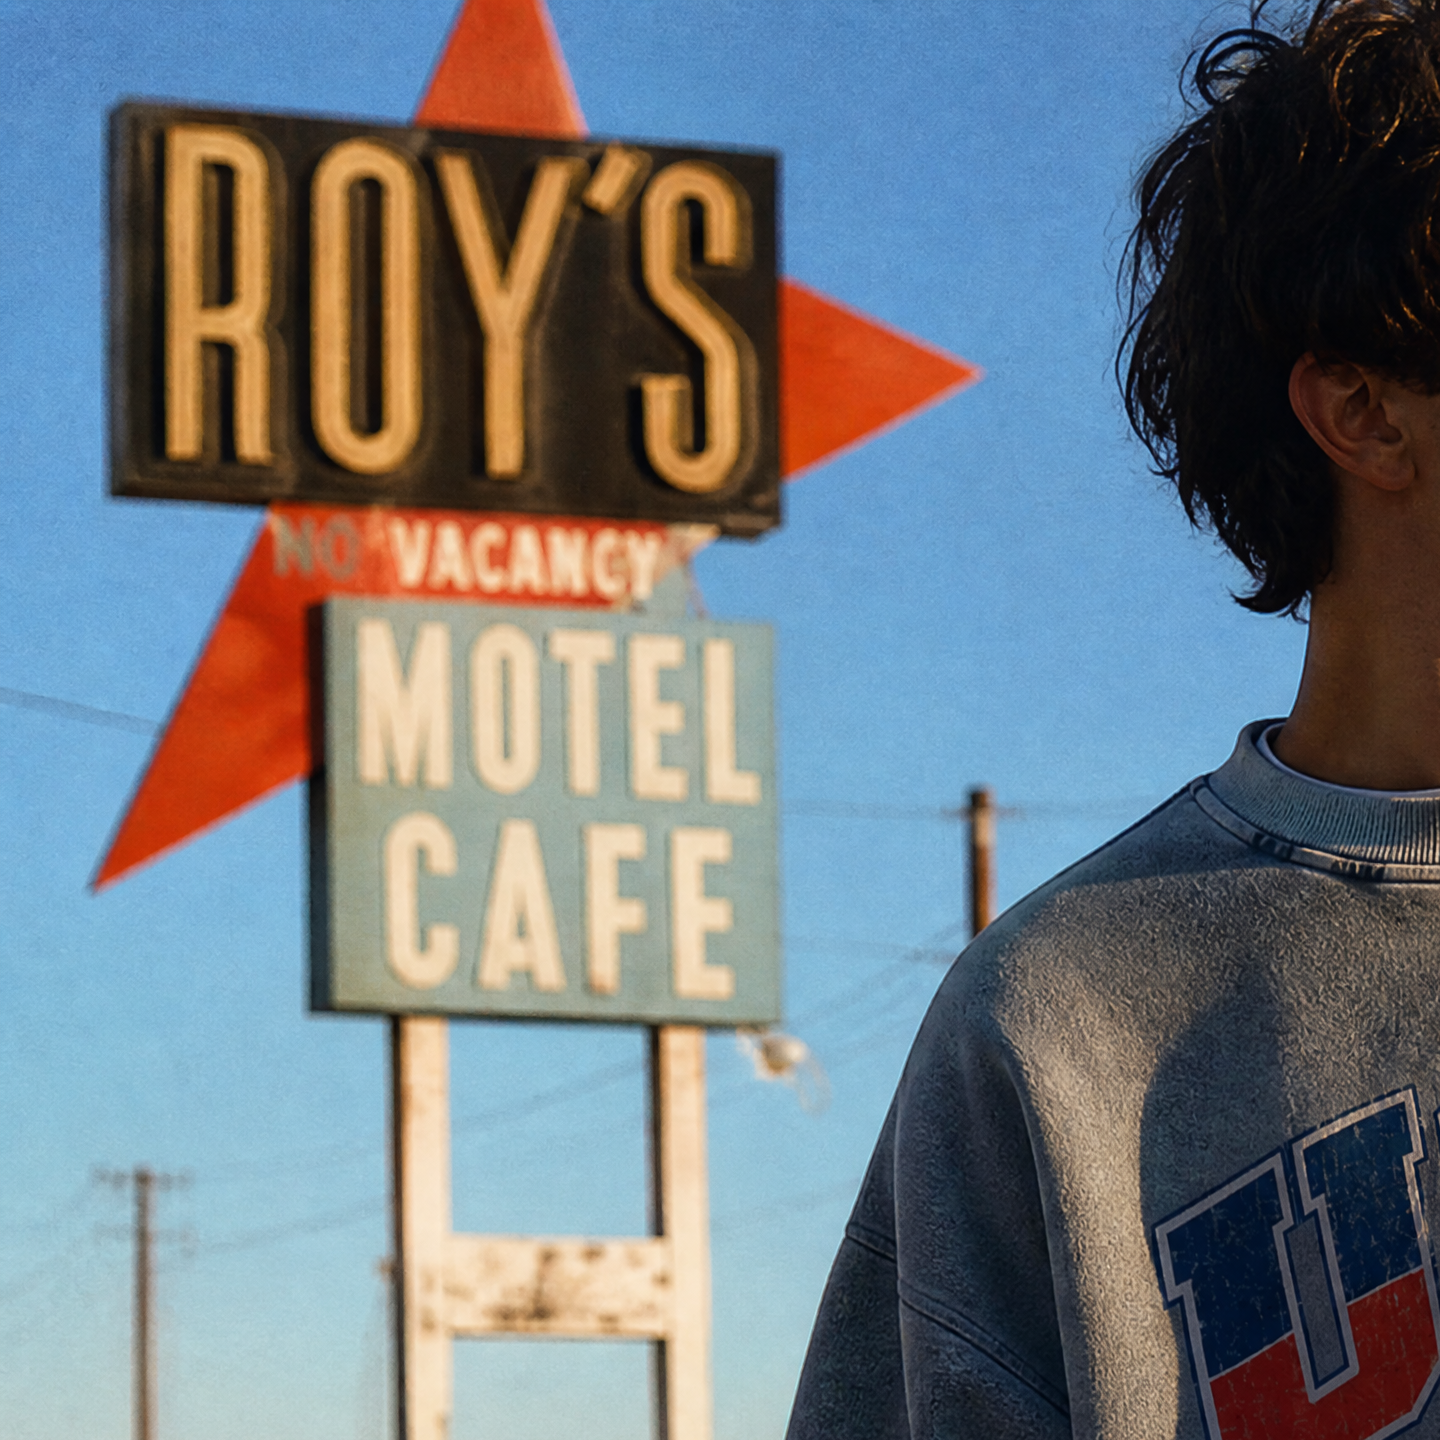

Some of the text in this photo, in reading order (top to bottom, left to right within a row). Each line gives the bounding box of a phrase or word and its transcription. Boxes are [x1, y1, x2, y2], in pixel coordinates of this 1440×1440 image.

[164, 125, 744, 491] ROY'S
[272, 513, 664, 600] NO VACANCY
[356, 618, 762, 804] MOTEL
[383, 812, 736, 999] CAFE
